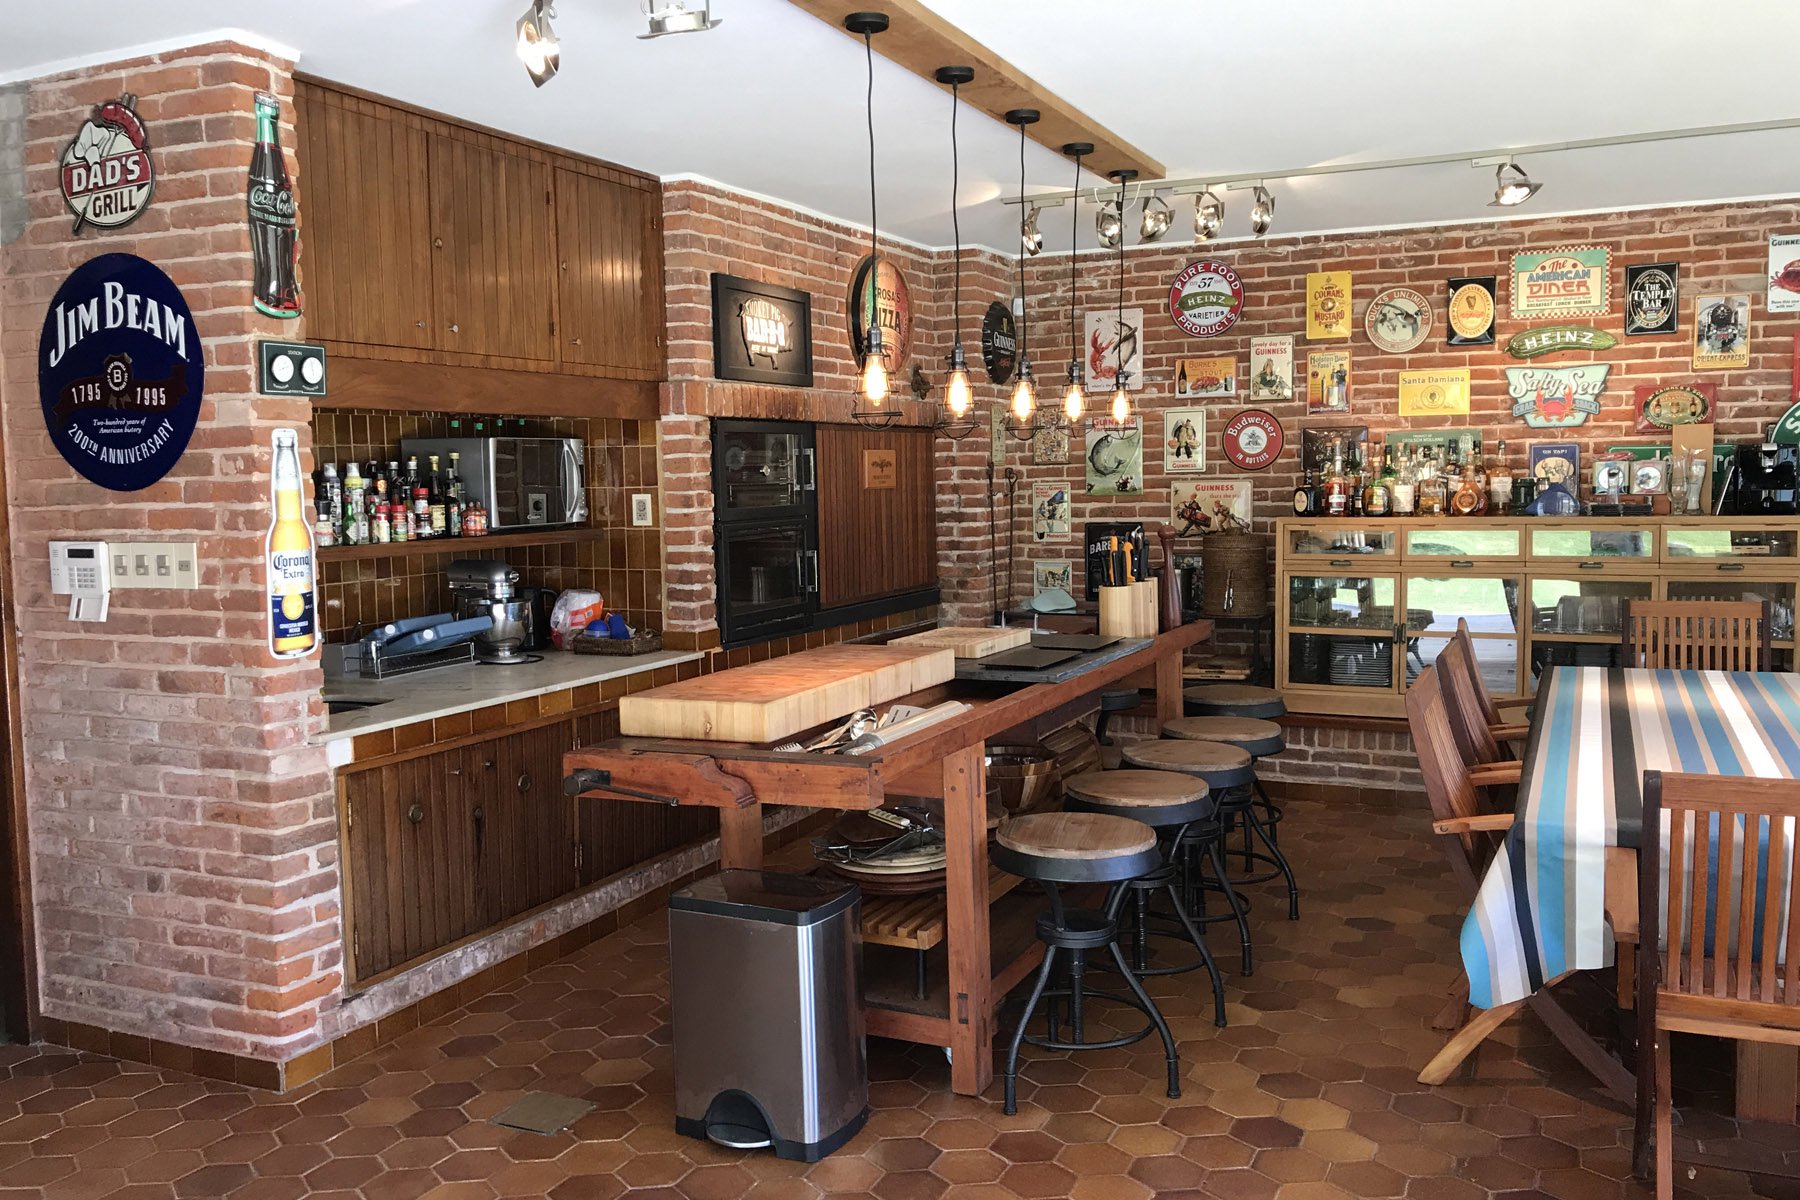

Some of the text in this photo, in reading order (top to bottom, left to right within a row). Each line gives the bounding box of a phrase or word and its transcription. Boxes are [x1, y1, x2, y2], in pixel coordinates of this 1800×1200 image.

[72, 155, 140, 193] DAD'S
[93, 189, 137, 218] GRILL
[1548, 260, 1568, 273] The
[1175, 263, 1239, 291] PURE FOOD
[1198, 277, 1214, 289] 57
[1527, 269, 1591, 283] AMERICAN
[1527, 280, 1591, 295] DINER
[1644, 283, 1661, 291] THE
[877, 287, 901, 303] ROSA'S
[1188, 295, 1226, 306] HEINZ
[1632, 289, 1672, 301] TEMPLE
[1368, 290, 1430, 321] DUCKS UNLIMITED
[1643, 300, 1662, 309] BAR
[877, 307, 901, 335] IZZA
[1189, 310, 1225, 320] VARIETIES
[1314, 310, 1345, 321] MUSTARD
[50, 281, 187, 367] JIM BEAM
[1178, 311, 1235, 334] PRODUCTS
[1524, 330, 1594, 350] HEINZ
[1255, 348, 1287, 356] GUINNESS
[113, 369, 122, 383] B
[1402, 377, 1426, 385] Santa
[1509, 369, 1605, 398] Salty Sea
[72, 383, 166, 406] 1795 1995
[93, 418, 126, 426] Two-hundred
[140, 417, 147, 426] of
[1227, 416, 1277, 437] Budweiser
[100, 418, 174, 465] ANNIVERSARY
[1195, 484, 1235, 492] GUINNESS
[273, 554, 310, 571] Corona
[283, 568, 305, 579] Extra
